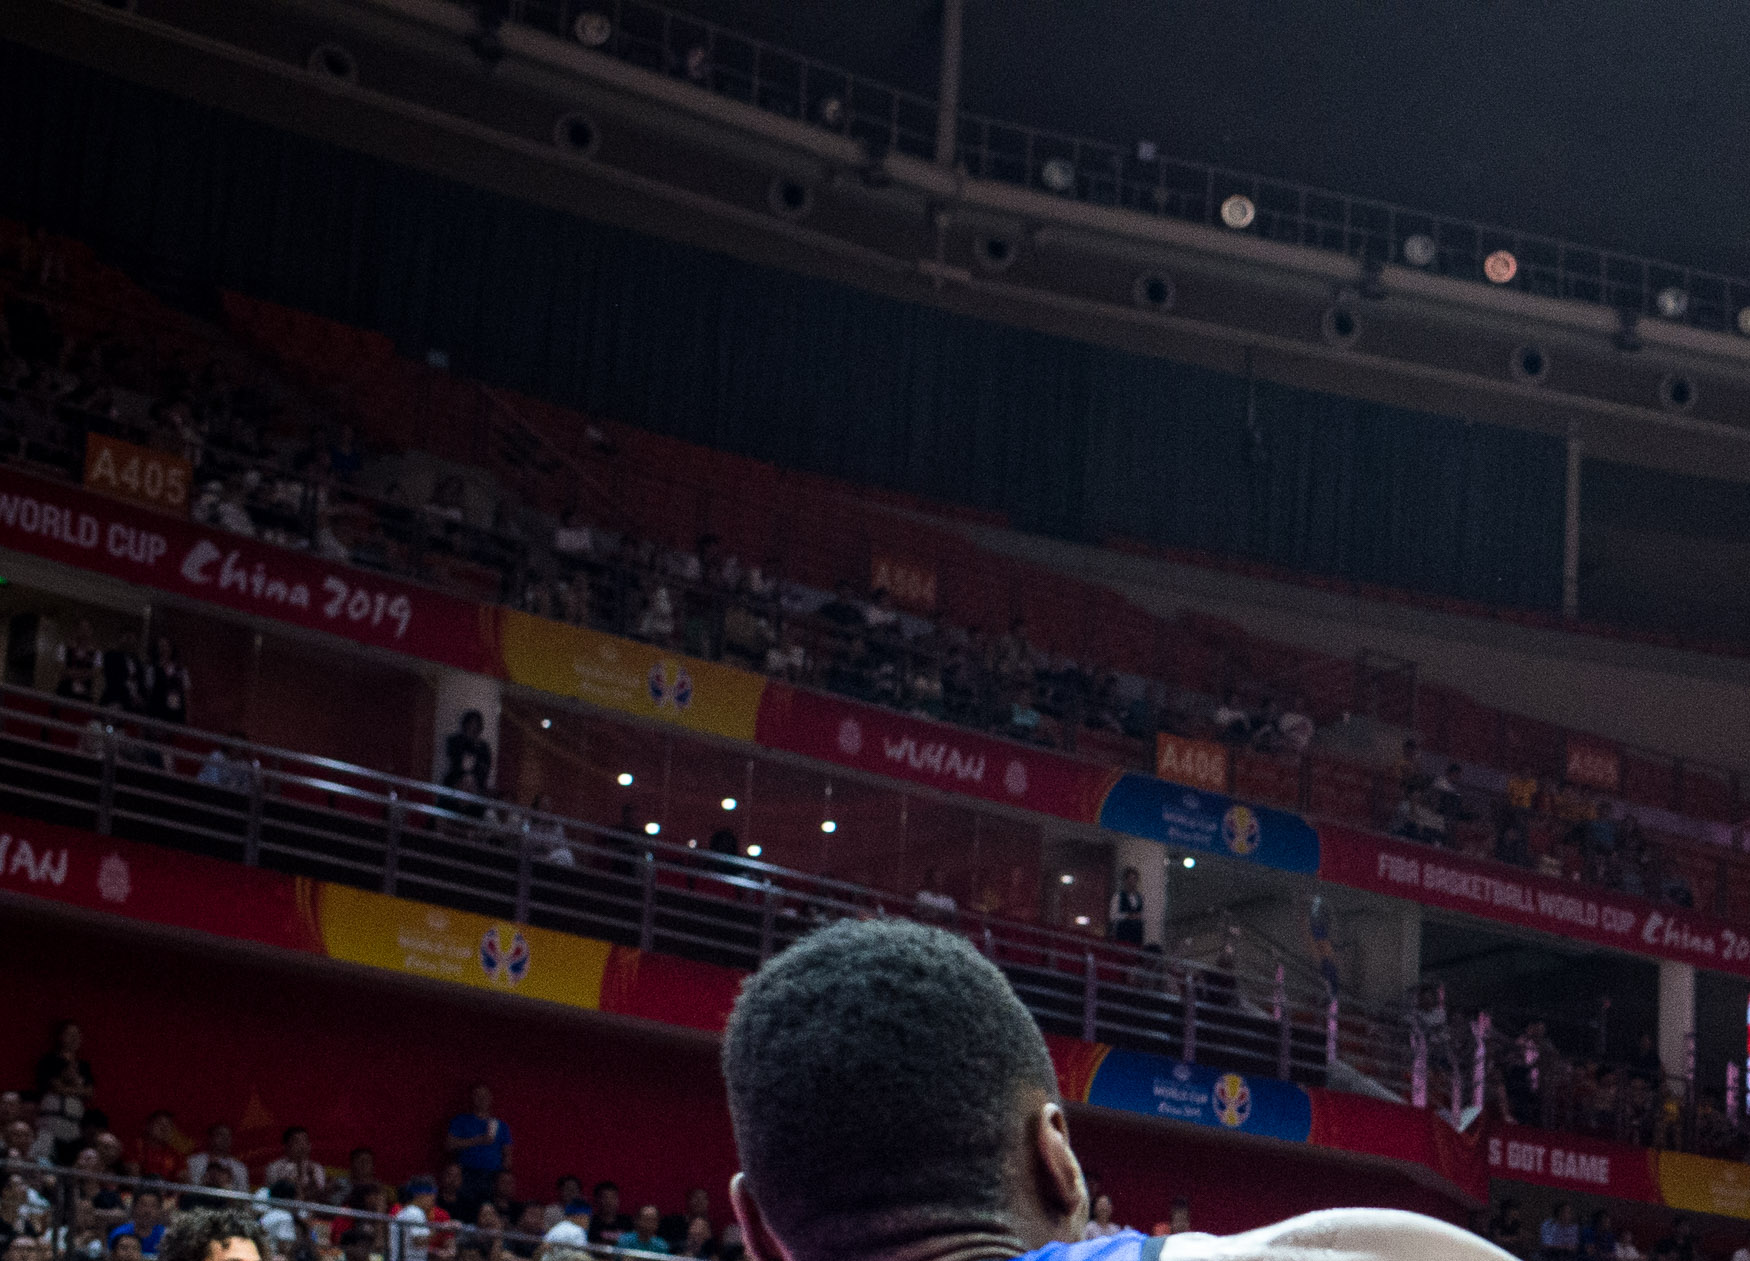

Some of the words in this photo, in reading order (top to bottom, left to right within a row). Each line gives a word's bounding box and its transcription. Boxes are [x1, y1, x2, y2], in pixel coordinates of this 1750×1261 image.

[90, 447, 188, 506] A405
[0, 493, 99, 549] WORLD
[106, 514, 168, 566] CUP
[180, 538, 311, 609] China
[321, 574, 413, 639] 2019
[0, 833, 69, 887] AN
[1423, 863, 1535, 914] BASKETBALL
[1537, 889, 1598, 927] WORLD
[1601, 904, 1637, 935] CUP
[1641, 911, 1716, 955] China
[1550, 1148, 1611, 1185] GAME
